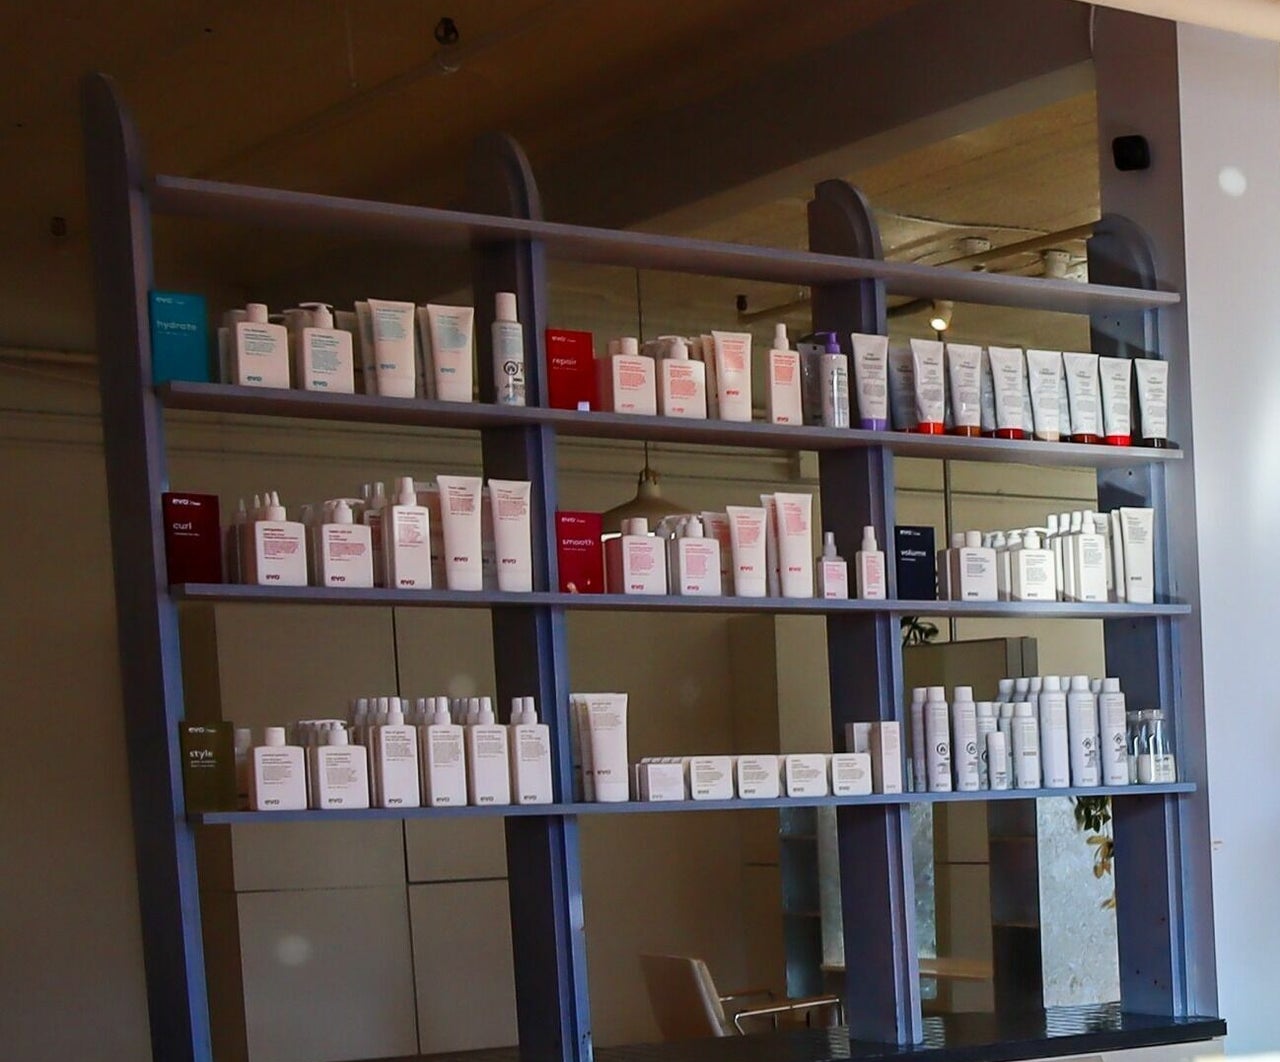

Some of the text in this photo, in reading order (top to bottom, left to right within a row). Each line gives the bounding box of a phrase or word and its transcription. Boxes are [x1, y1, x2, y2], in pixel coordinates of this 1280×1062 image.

[156, 320, 197, 332] hydrate
[552, 357, 577, 366] repair
[172, 521, 192, 530] curl
[562, 538, 595, 547] smooth
[901, 549, 927, 557] volume
[189, 749, 213, 760] style
